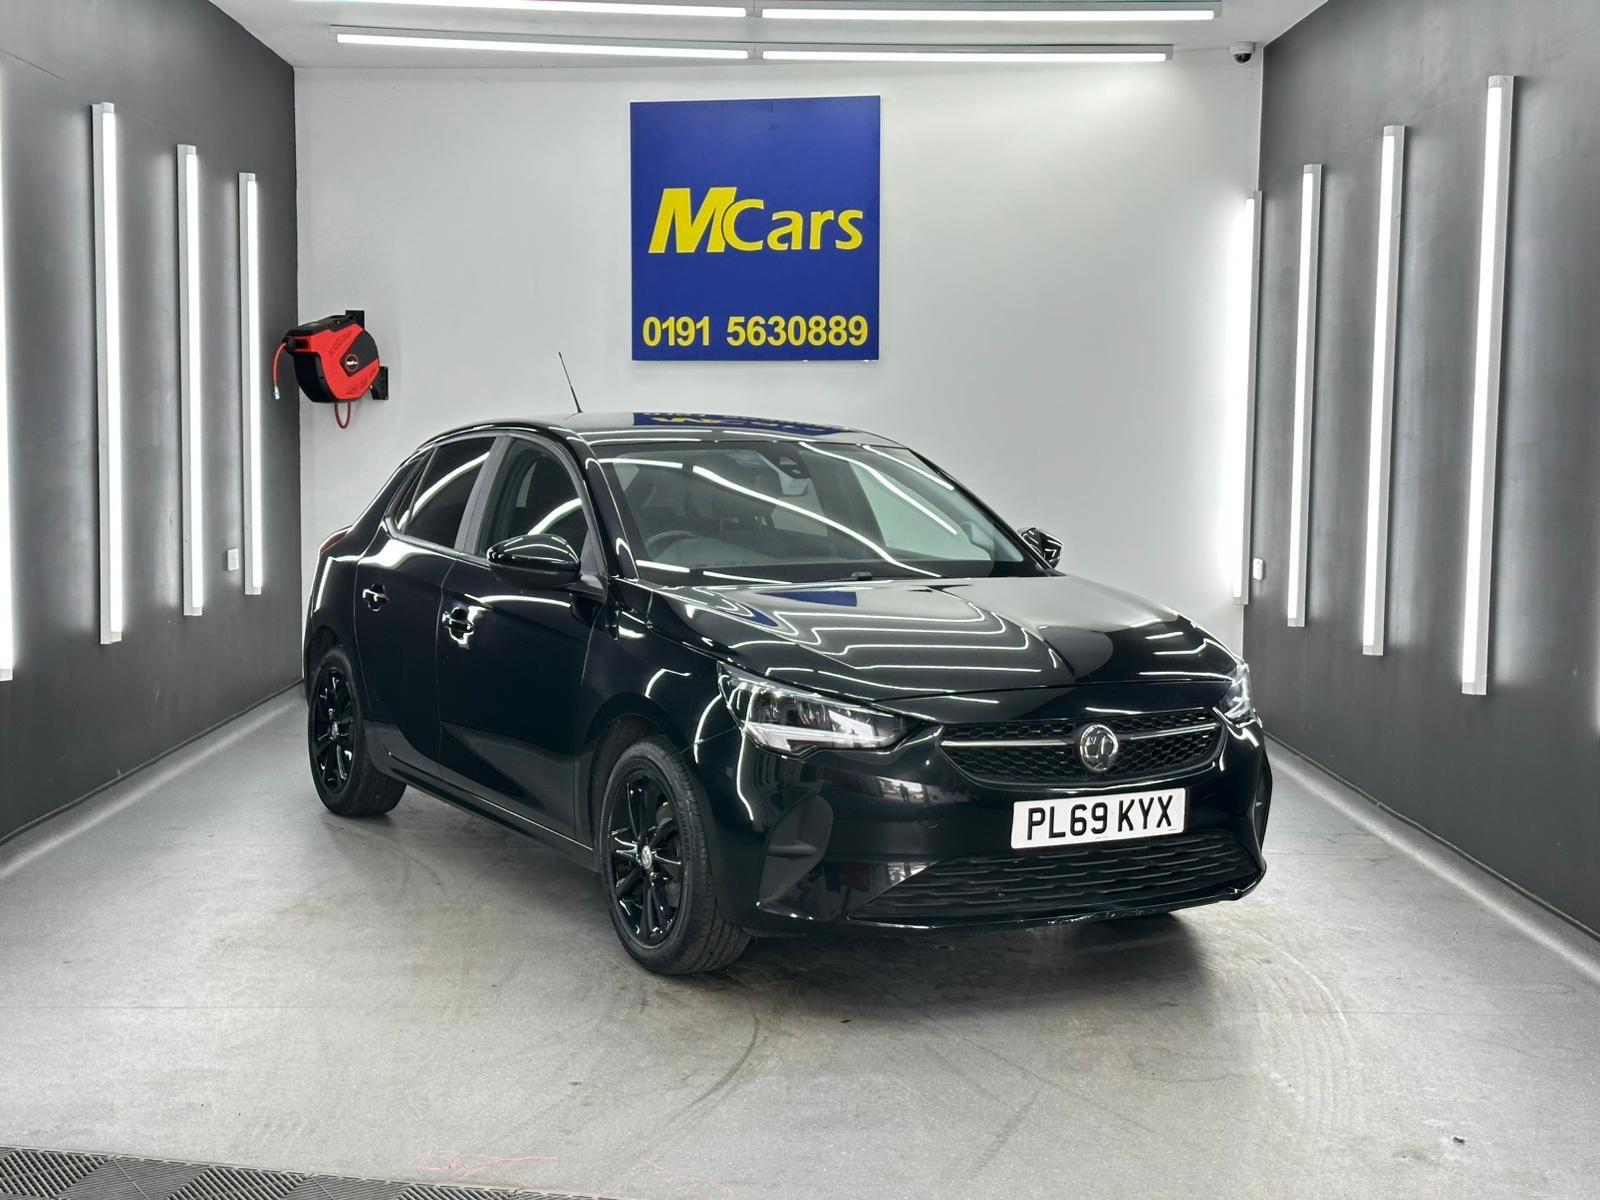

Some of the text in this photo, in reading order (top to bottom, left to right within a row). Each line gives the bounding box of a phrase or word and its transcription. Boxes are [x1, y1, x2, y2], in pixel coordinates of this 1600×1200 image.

[642, 315, 869, 347] 0191 5630889
[1026, 794, 1174, 841] PL69 KYX
